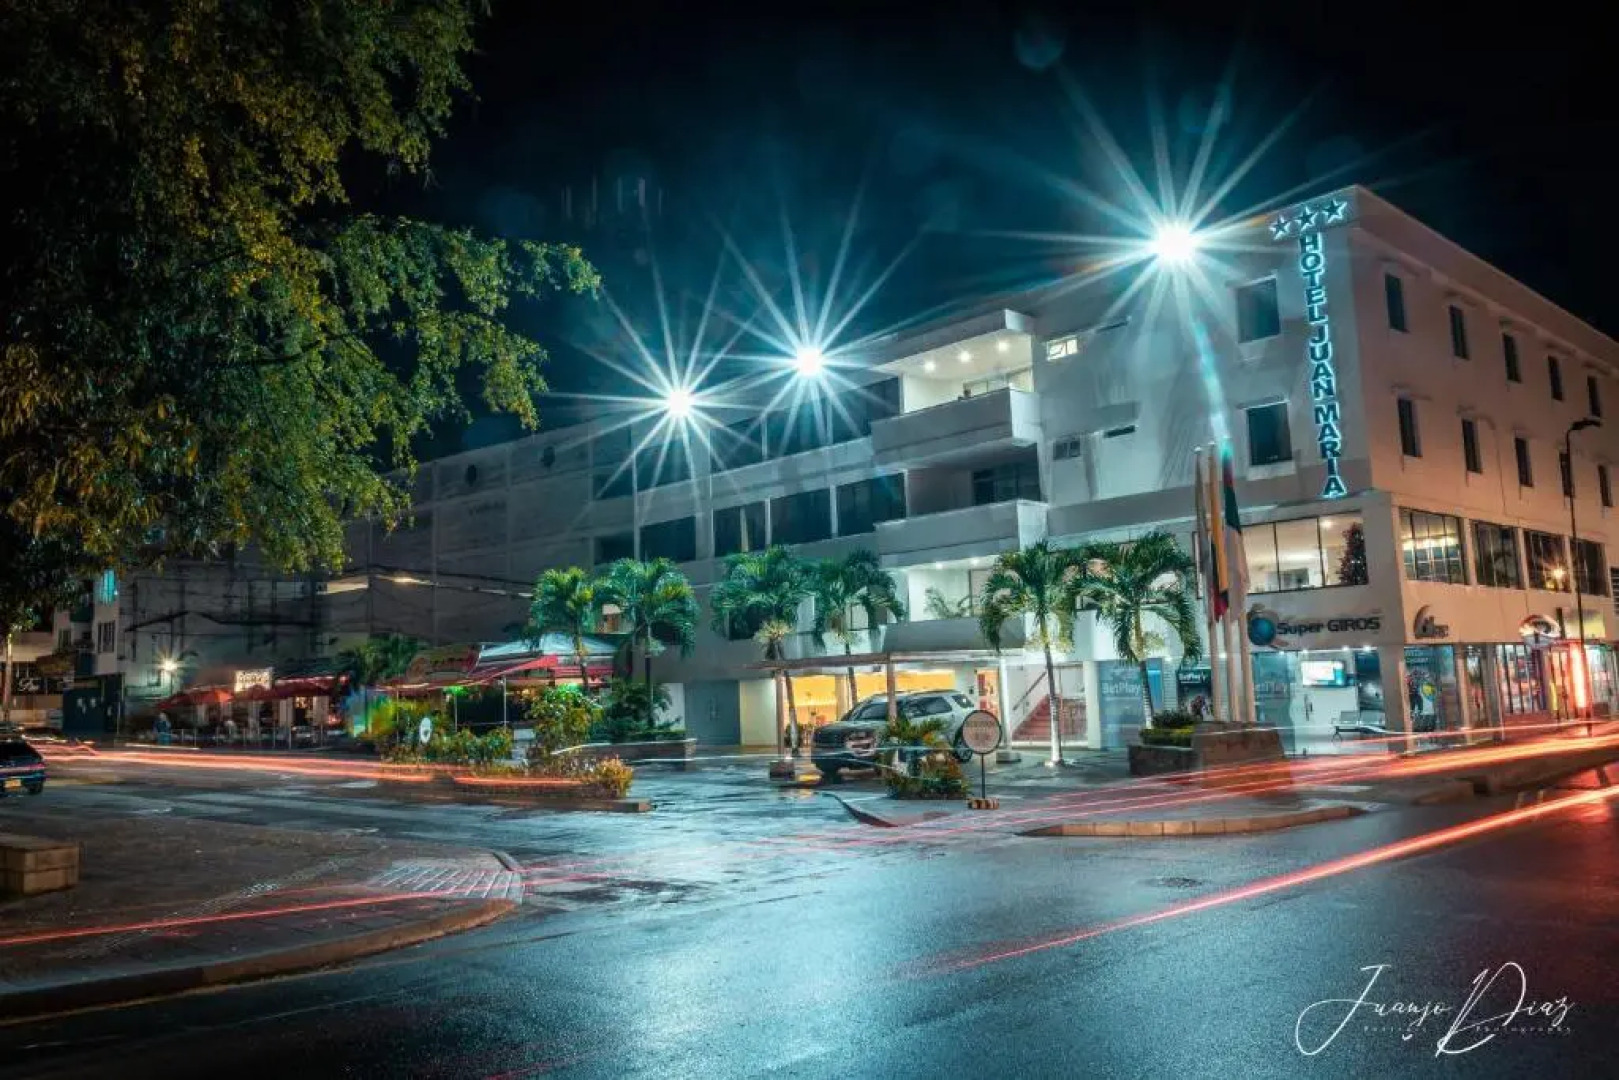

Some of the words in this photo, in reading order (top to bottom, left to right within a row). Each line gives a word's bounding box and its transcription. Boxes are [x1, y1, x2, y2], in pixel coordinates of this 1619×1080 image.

[1300, 231, 1328, 324] HOTEL
[1308, 325, 1336, 399] JUAN
[1314, 402, 1347, 497] MARIA
[1276, 621, 1324, 637] Super
[1327, 616, 1381, 632] GIROS
